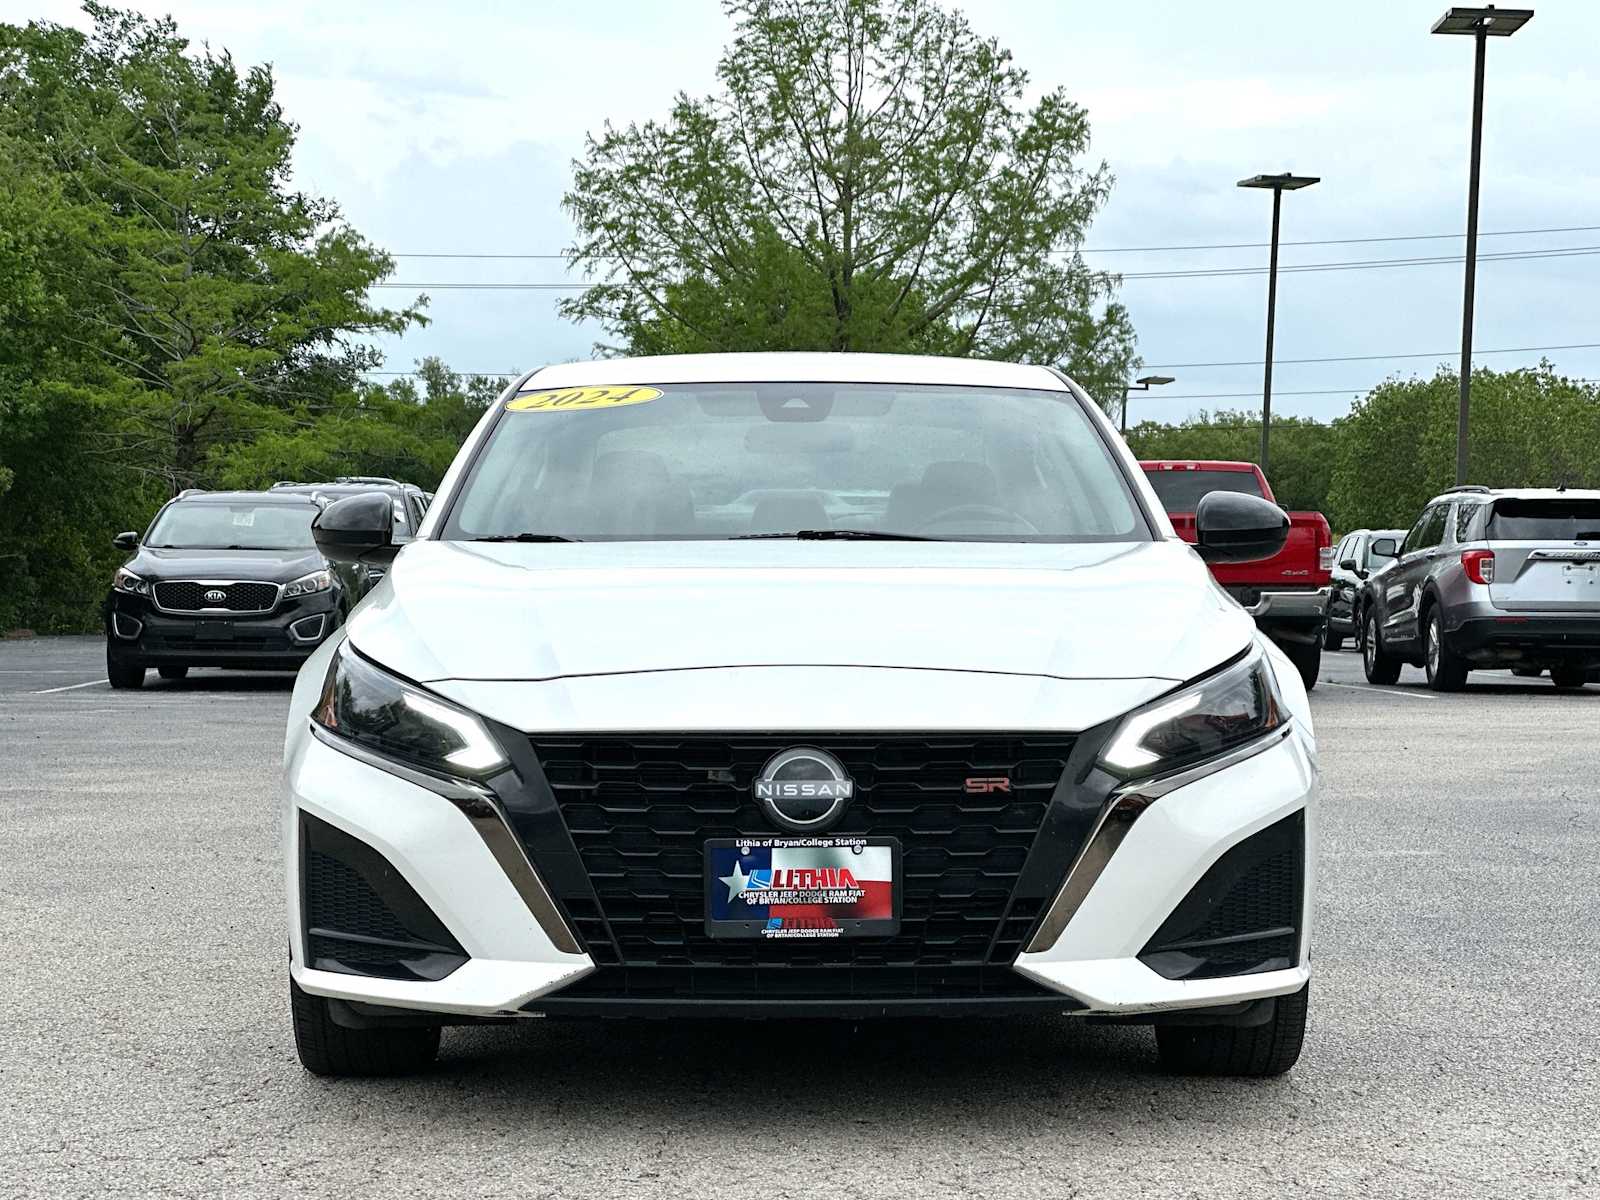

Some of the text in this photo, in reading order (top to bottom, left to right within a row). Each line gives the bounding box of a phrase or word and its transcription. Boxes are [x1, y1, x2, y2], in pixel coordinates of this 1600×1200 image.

[525, 388, 643, 409] 2024
[207, 592, 224, 600] KIA
[757, 782, 850, 796] NISSAN
[965, 777, 1010, 792] SR
[735, 837, 867, 848] Lithia of Bryan/College Station
[772, 867, 860, 889] LITHIA
[738, 891, 779, 899] CHRYSLER
[799, 890, 828, 898] DODGE
[746, 896, 858, 905] OF BRYAN/COLLEGE STATION
